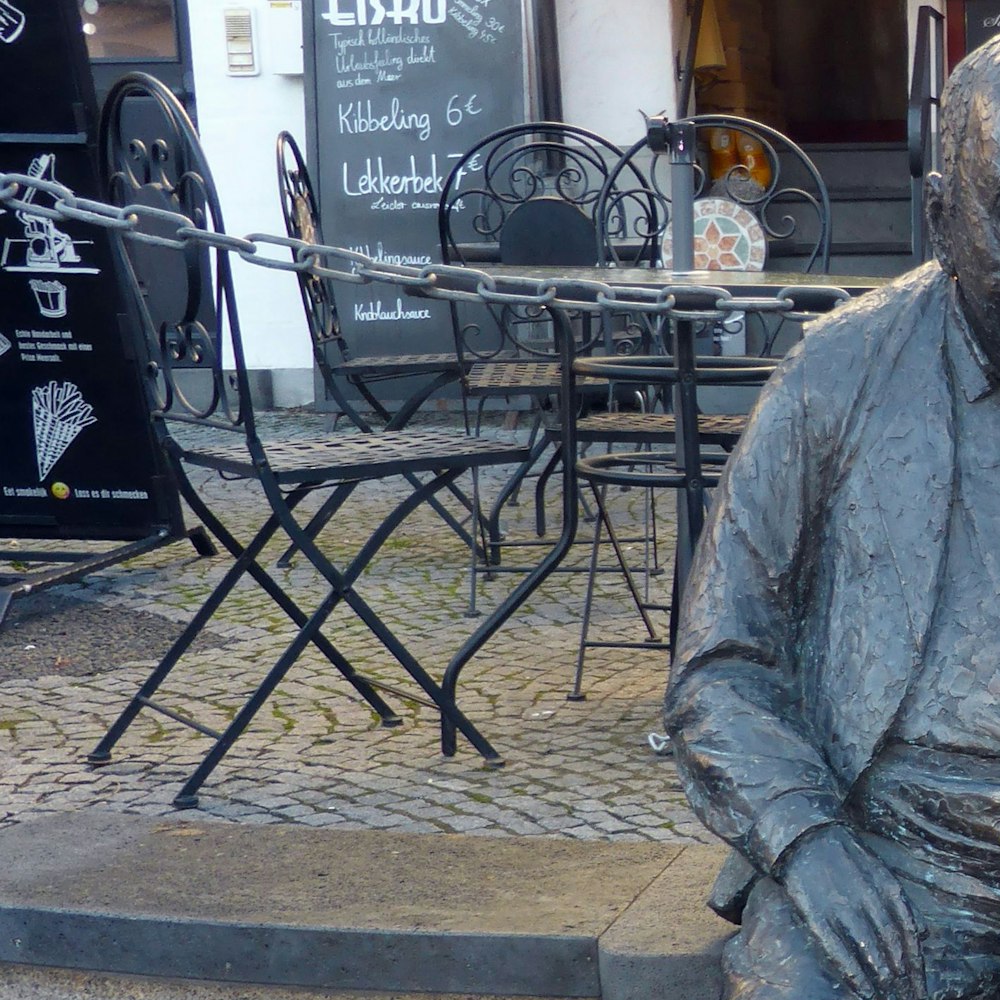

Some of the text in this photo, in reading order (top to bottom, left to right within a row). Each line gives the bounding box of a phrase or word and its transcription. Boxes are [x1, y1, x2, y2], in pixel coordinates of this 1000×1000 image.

[338, 94, 483, 141] Kibbeling 6€
[343, 154, 444, 197] Lekkerbek
[354, 297, 432, 322] Knoblauchsauce
[3, 486, 15, 496] Eet
[74, 488, 91, 498] Lass
[91, 490, 101, 499] es
[111, 489, 149, 500] schmecken
